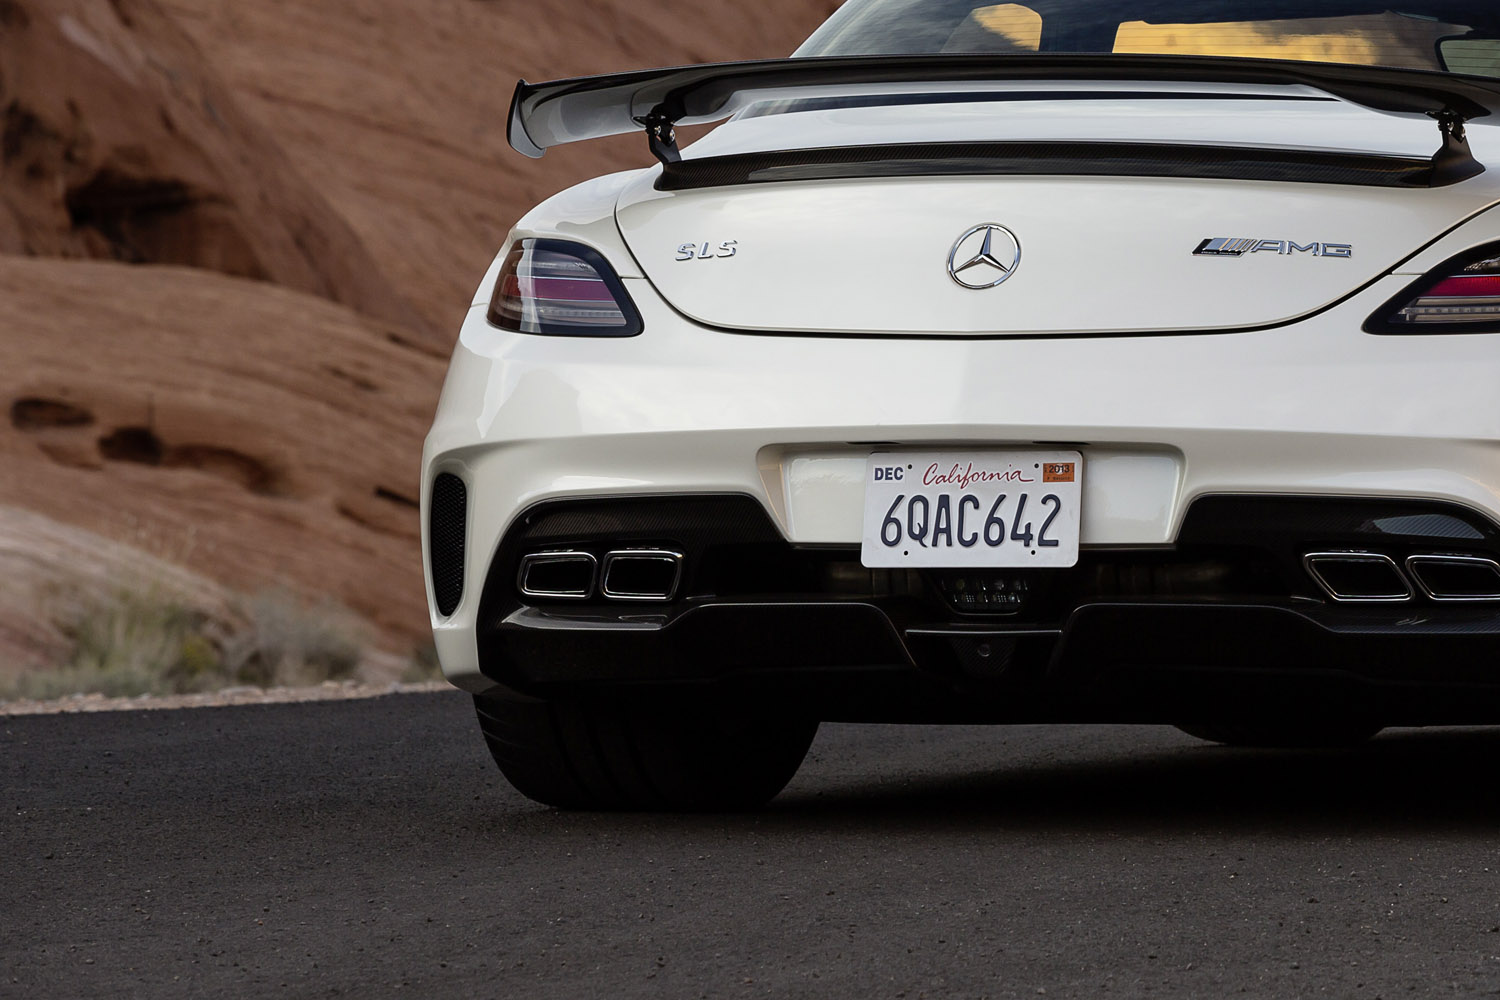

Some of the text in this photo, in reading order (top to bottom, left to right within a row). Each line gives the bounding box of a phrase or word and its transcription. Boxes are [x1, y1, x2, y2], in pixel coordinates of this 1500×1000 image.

[675, 239, 738, 262] SLS
[1250, 239, 1352, 258] AMG
[874, 466, 904, 481] DEC
[923, 462, 1034, 489] California
[1048, 464, 1070, 473] 2013
[880, 493, 1061, 548] 6QAC642
